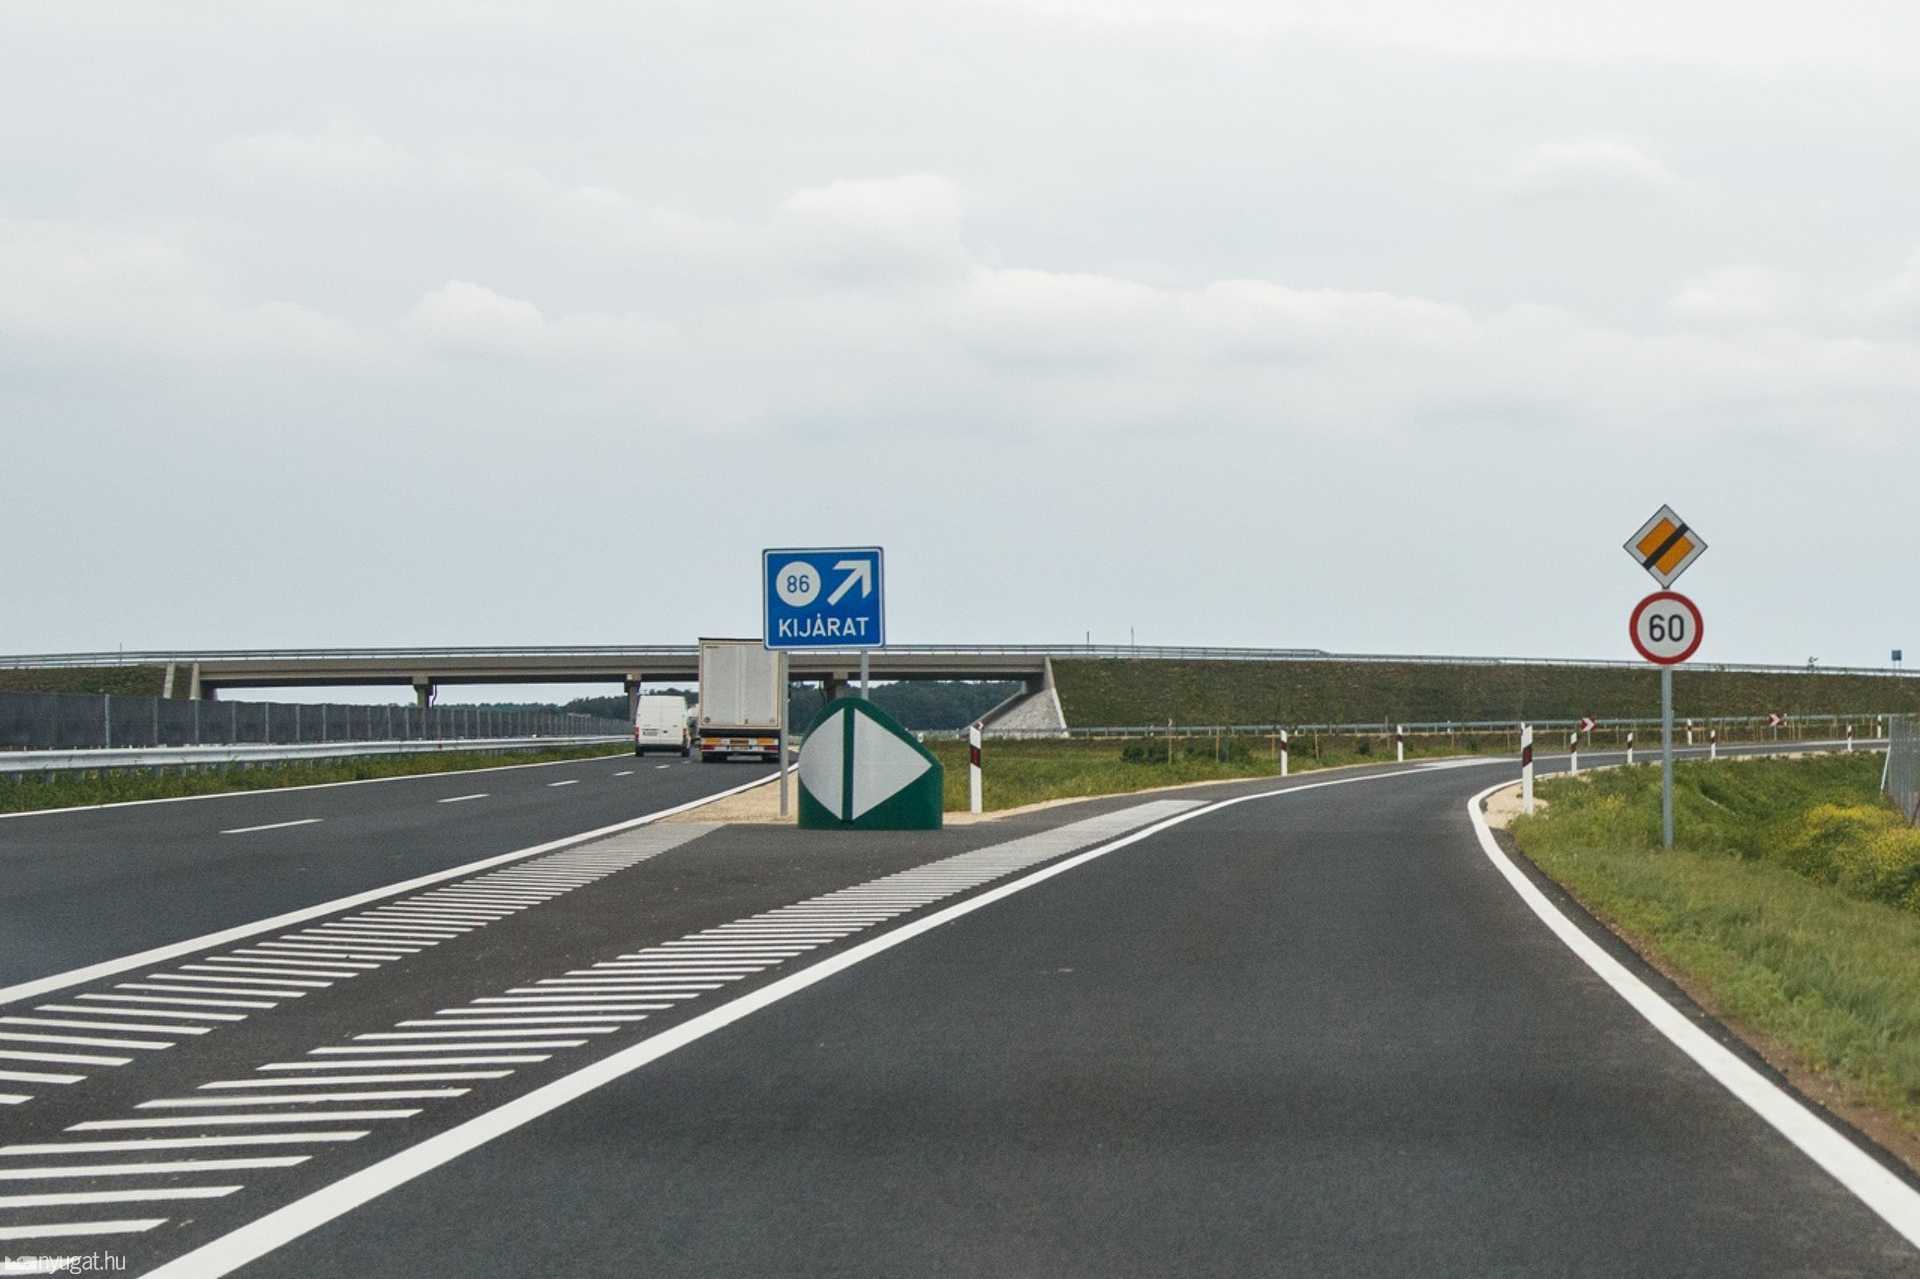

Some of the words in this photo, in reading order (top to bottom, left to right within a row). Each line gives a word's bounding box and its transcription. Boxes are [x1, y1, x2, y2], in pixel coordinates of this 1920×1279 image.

[786, 575, 810, 593] 86
[778, 613, 869, 637] KIJÁRAT
[1649, 614, 1684, 642] 60
